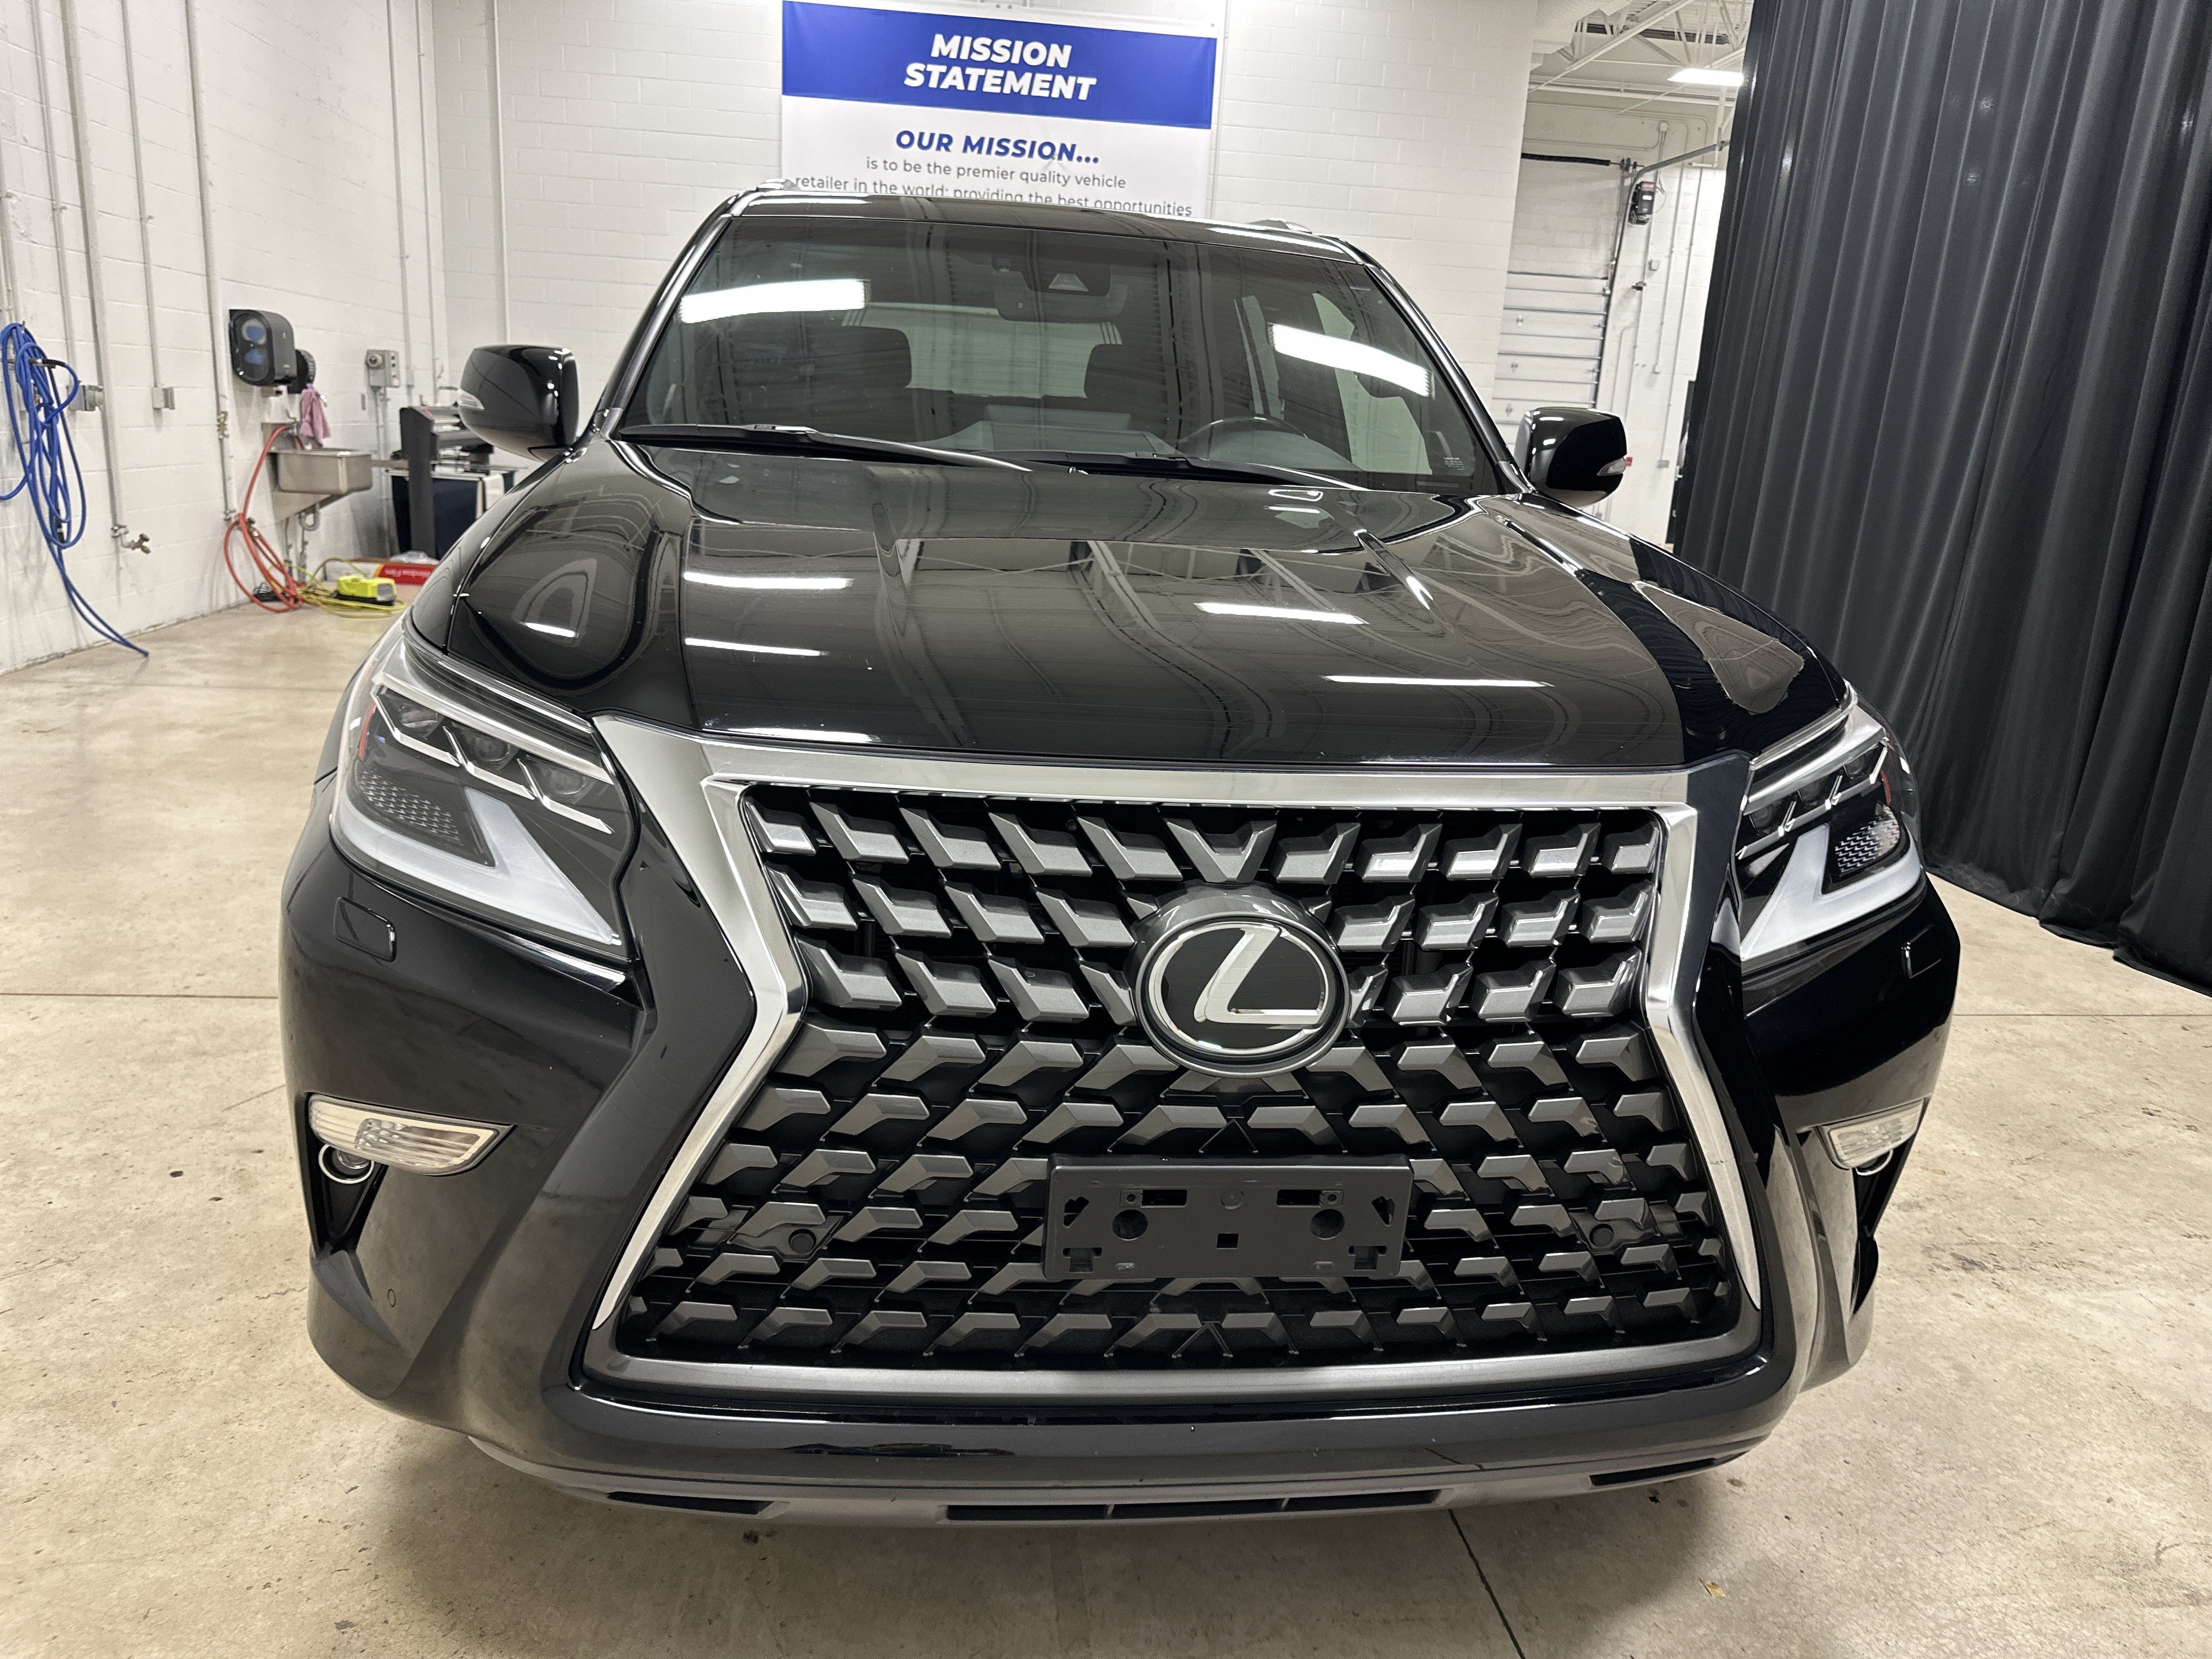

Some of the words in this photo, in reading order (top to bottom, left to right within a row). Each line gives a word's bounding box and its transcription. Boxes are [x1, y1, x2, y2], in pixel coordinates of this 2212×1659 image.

[930, 33, 1073, 69] MISSION
[904, 62, 1097, 100] STATEMENT
[895, 130, 953, 153] OUR
[962, 135, 1099, 163] MISSION...
[866, 156, 878, 170] is
[883, 159, 898, 171] to
[903, 159, 922, 173] be
[927, 162, 951, 175] the
[956, 166, 1015, 180] premier
[1019, 171, 1070, 187] quality
[1074, 174, 1126, 189] vehicle
[795, 176, 849, 191] retailer
[854, 178, 867, 193] in
[872, 180, 898, 194] the
[1028, 192, 1053, 204] the
[1058, 194, 1089, 206] best
